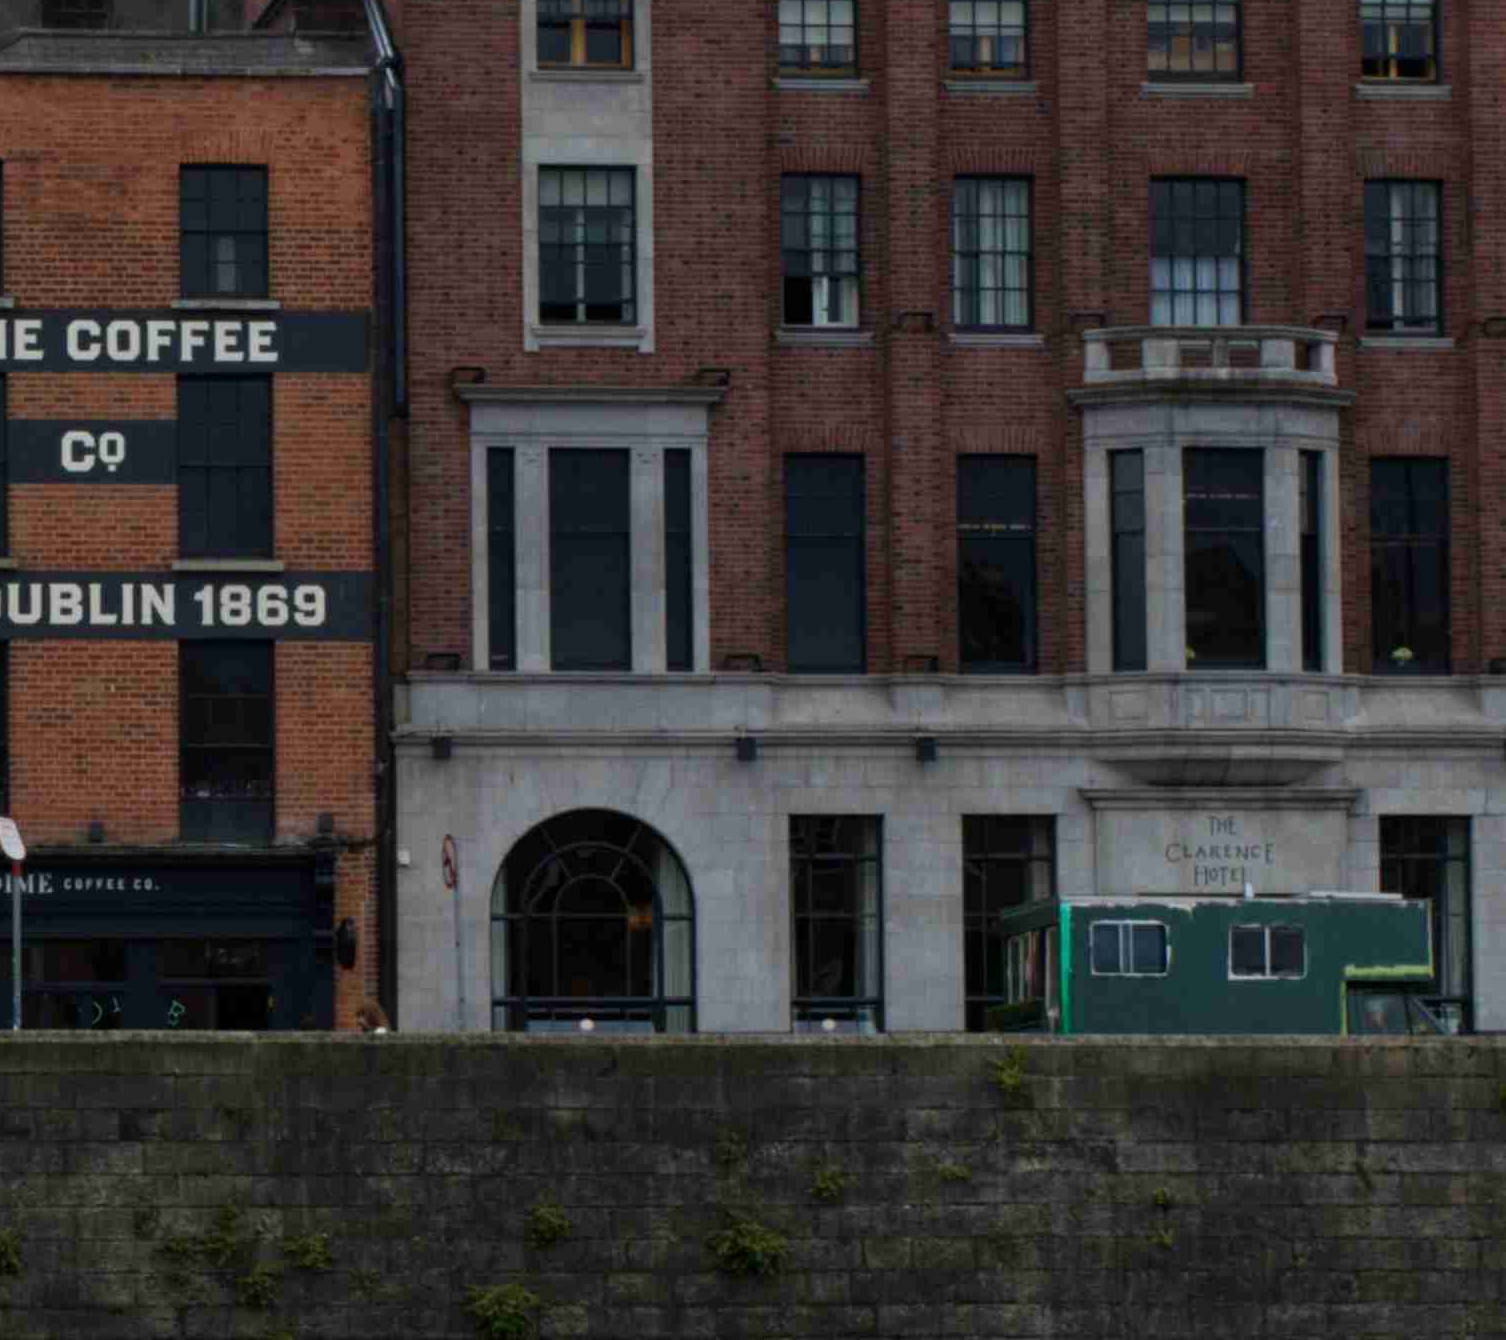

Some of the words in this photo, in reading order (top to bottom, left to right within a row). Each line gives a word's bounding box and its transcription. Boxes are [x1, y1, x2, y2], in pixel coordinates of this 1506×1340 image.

[65, 319, 279, 363] COFFEE
[194, 584, 326, 627] 1869
[1206, 816, 1237, 836] THE
[1164, 842, 1276, 864] CLARENCE
[62, 876, 126, 891] COFFEE
[1194, 865, 1250, 887] HOTEL
